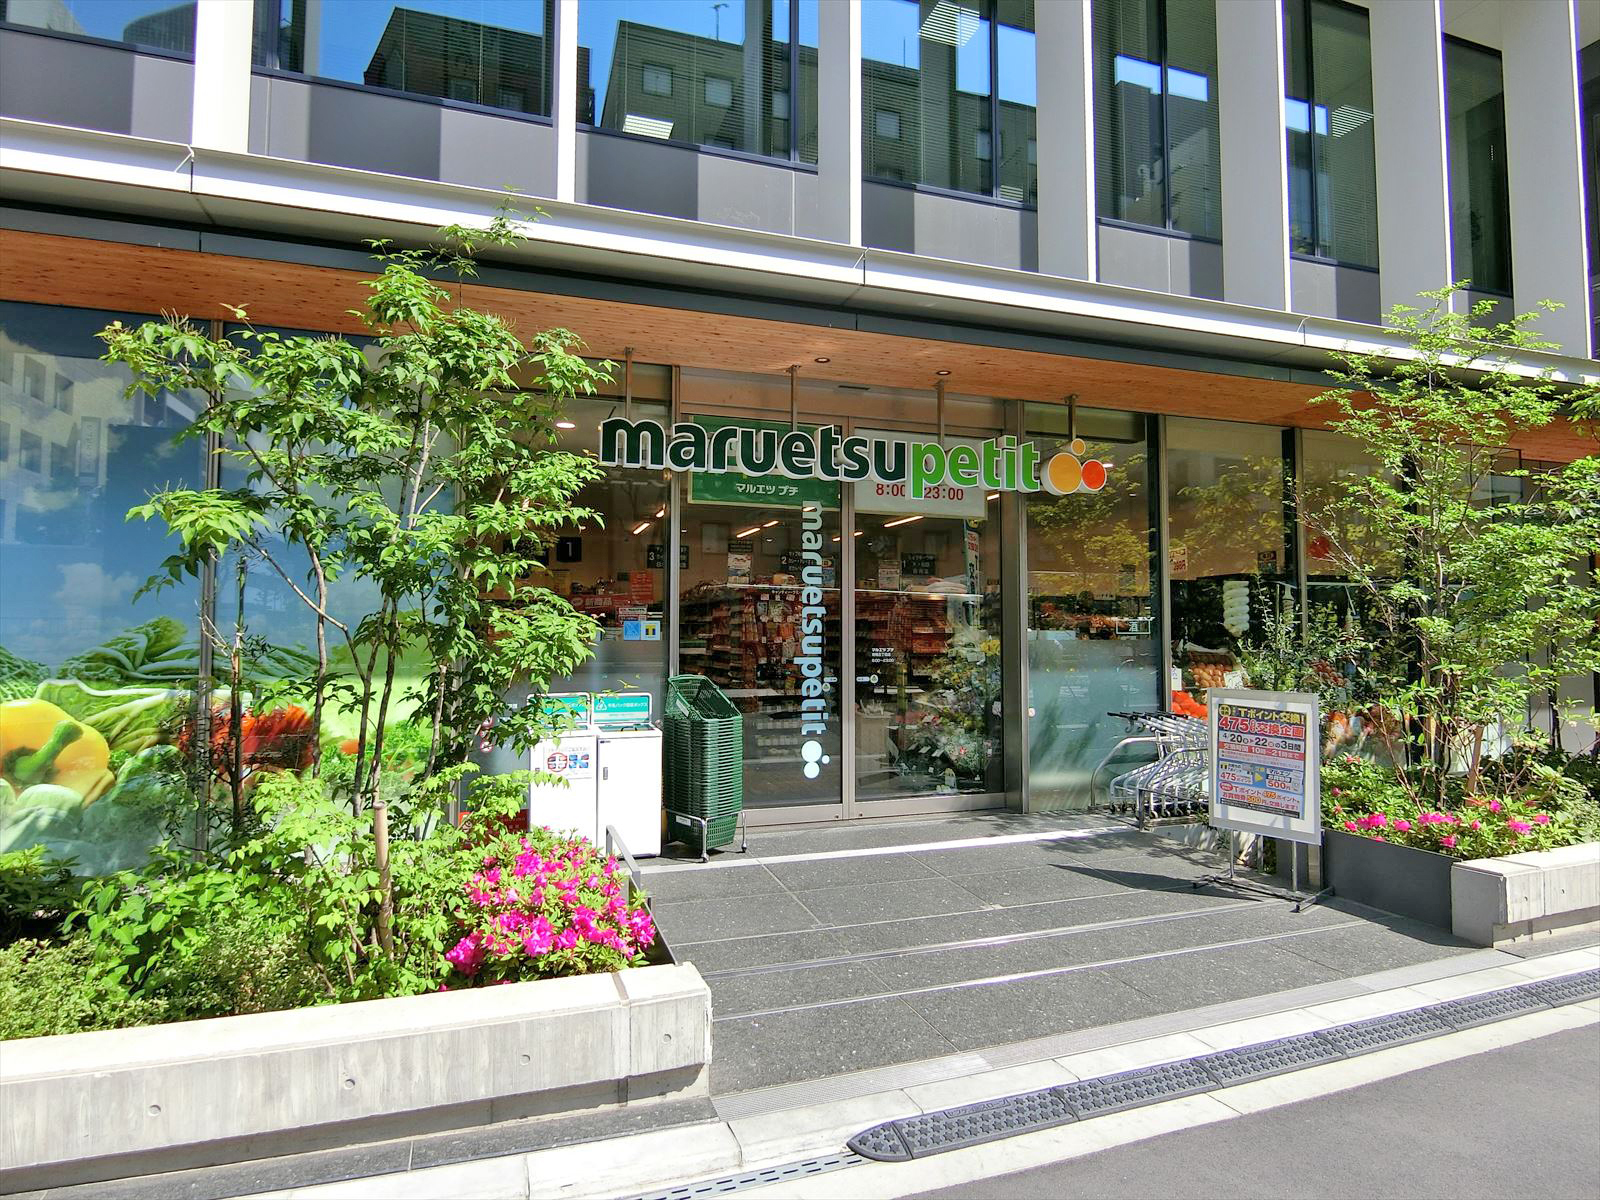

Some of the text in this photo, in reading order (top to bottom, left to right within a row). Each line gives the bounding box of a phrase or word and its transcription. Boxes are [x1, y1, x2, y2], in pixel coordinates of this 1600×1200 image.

[735, 483, 799, 497] マルエツ プチ
[875, 483, 964, 501] 8:00 23:00
[566, 541, 573, 557] 1
[649, 552, 655, 561] 3
[781, 555, 788, 565] 2
